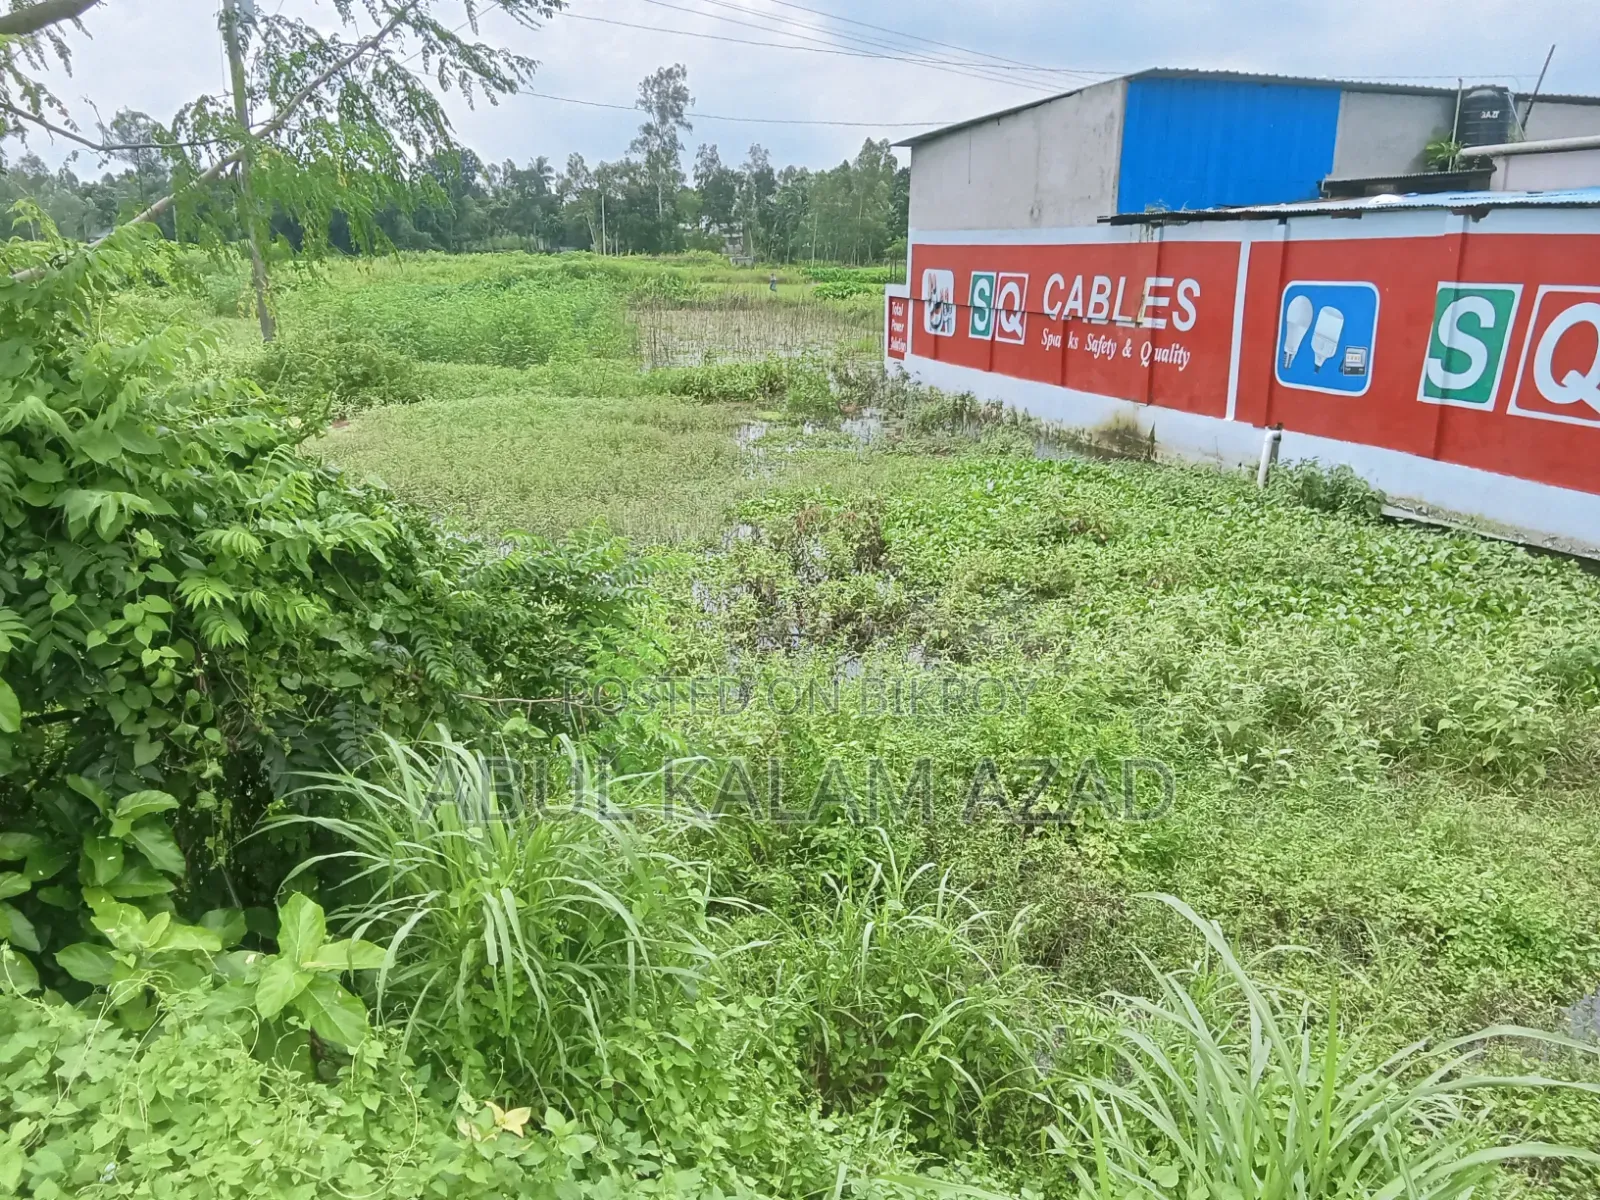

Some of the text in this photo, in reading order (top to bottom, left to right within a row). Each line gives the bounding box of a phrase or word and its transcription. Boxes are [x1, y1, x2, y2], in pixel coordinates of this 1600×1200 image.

[1043, 273, 1200, 332] CABLES
[1084, 333, 1117, 360] Safety
[1122, 338, 1132, 358] &
[1140, 341, 1191, 371] Quality
